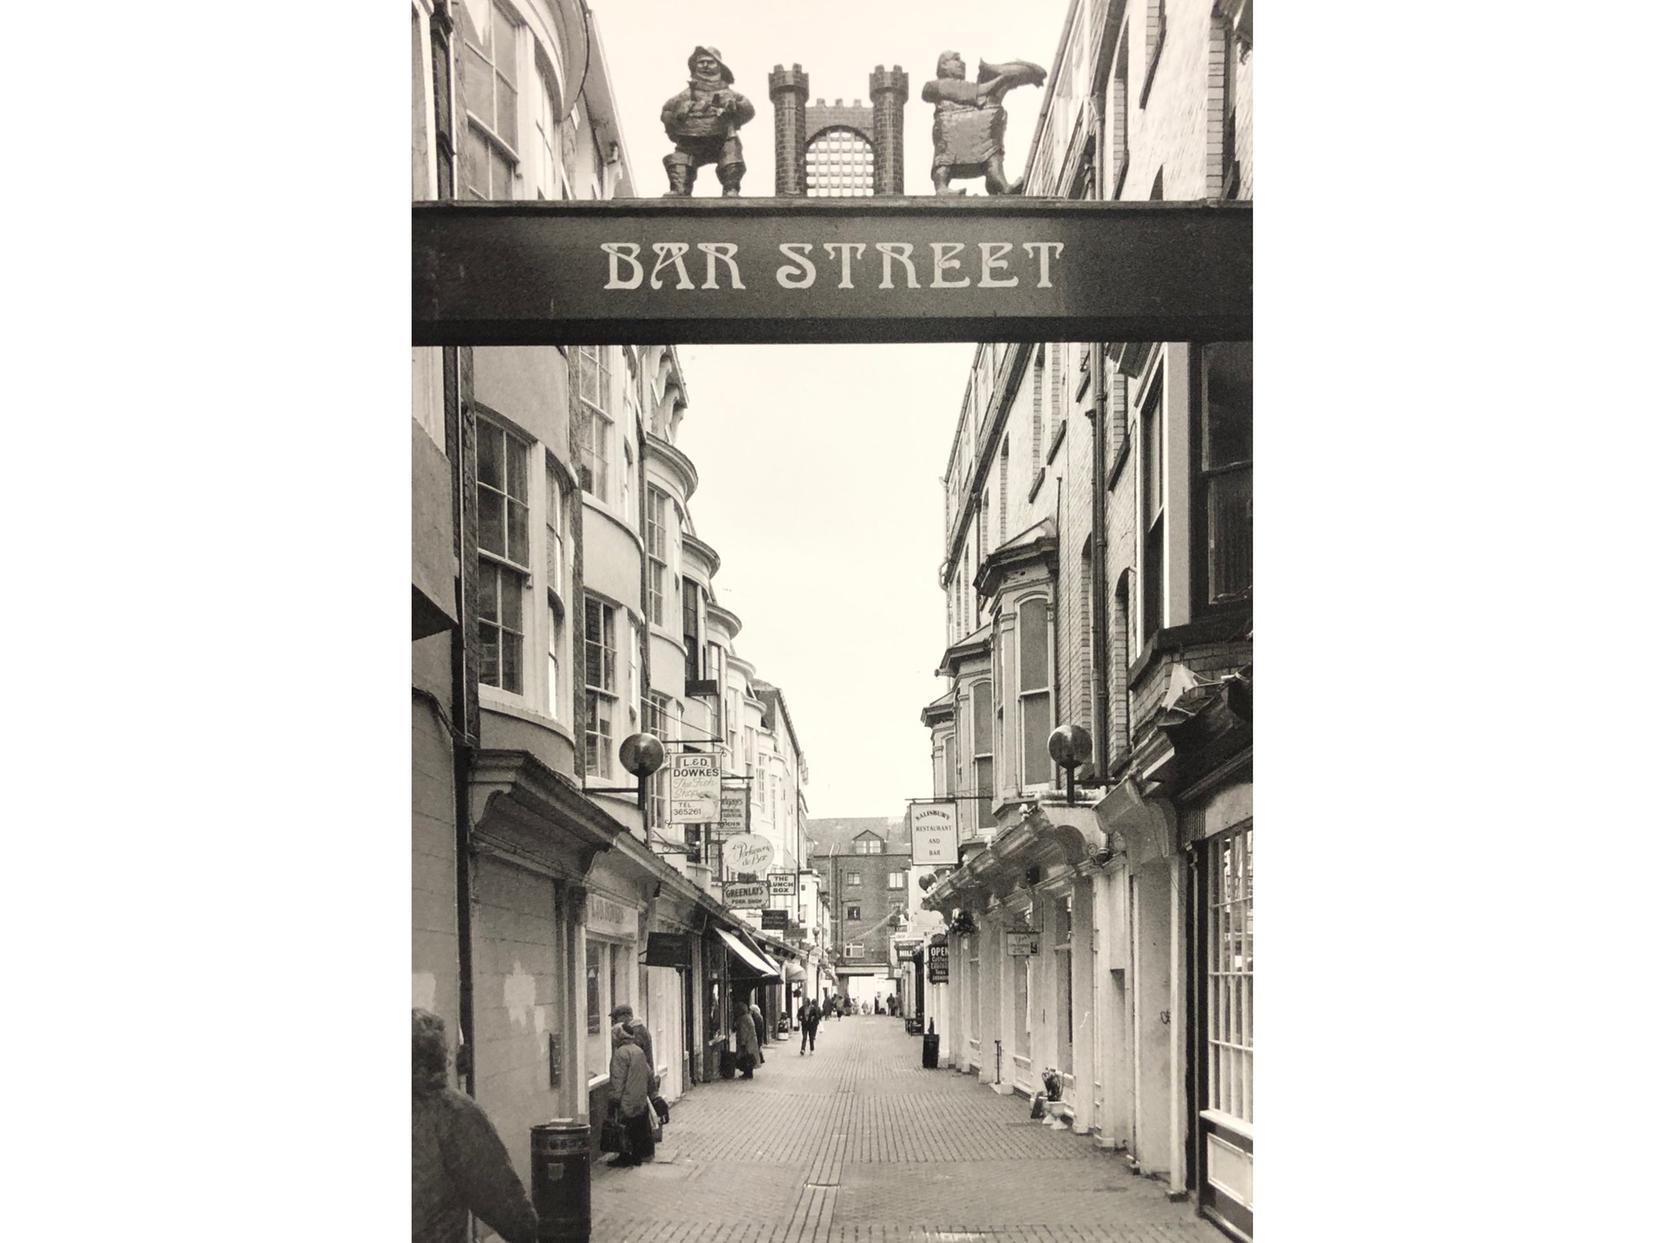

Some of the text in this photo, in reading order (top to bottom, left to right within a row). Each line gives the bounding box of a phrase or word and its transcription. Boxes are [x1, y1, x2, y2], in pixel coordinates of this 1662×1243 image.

[600, 242, 1064, 290] BAR STREET
[673, 768, 719, 777] DOWKES
[673, 808, 702, 816] 365261
